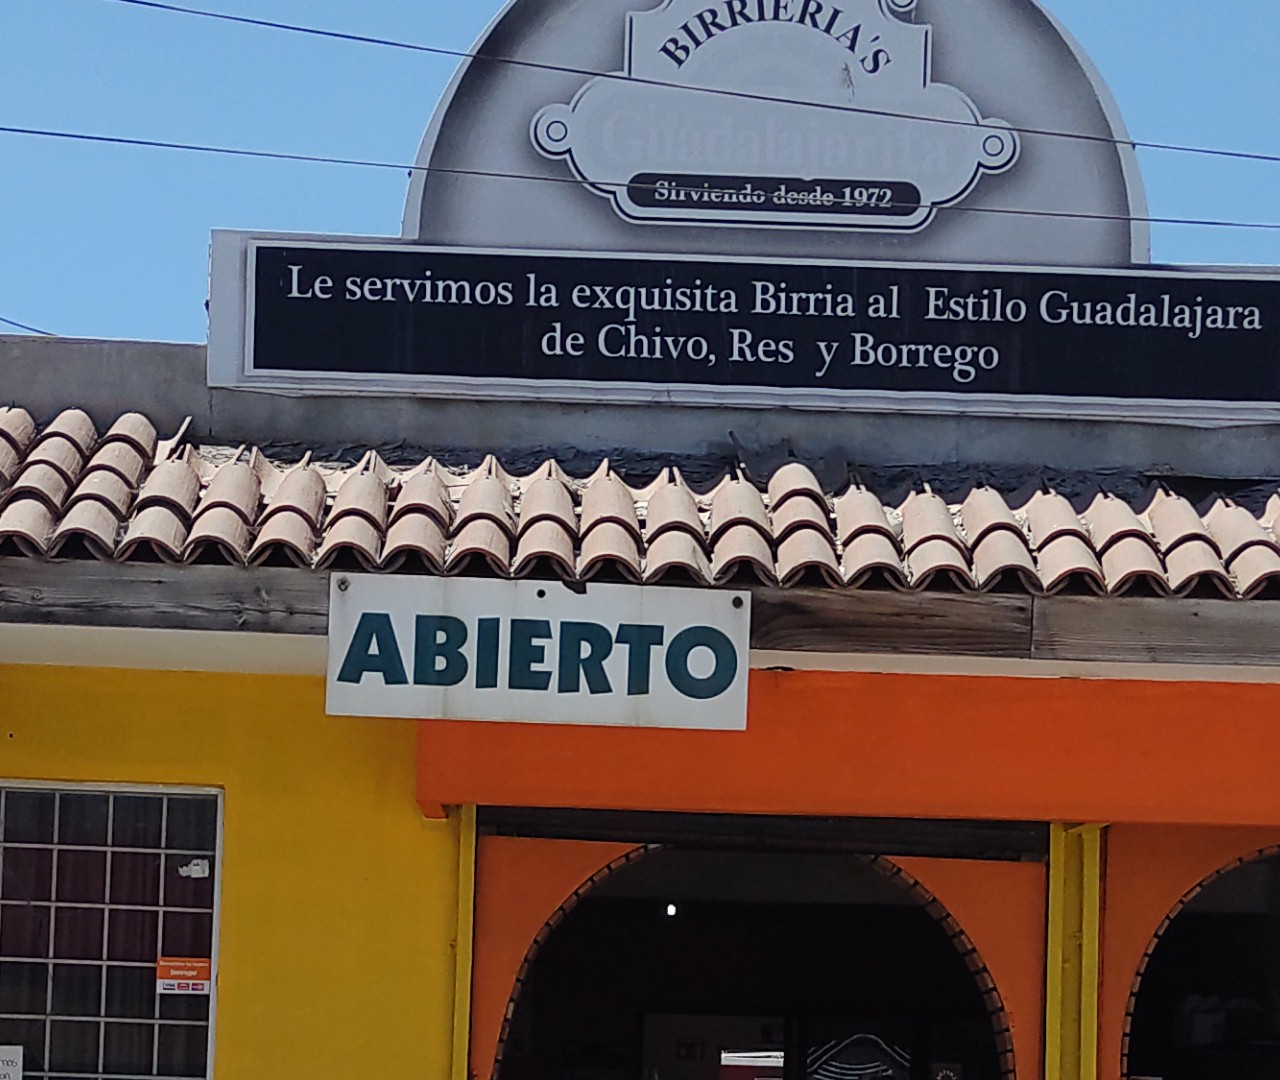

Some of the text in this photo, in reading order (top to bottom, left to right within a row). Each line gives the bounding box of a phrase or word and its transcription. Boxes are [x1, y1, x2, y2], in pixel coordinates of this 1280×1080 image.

[654, 180, 892, 208] Sirviendo desde 1972
[287, 264, 1263, 339] Le servimos la exquisita Birria al Estilo Guadalajara
[541, 323, 999, 383] de Chivo, Res y Borrego
[337, 611, 738, 699] ABIERTO
